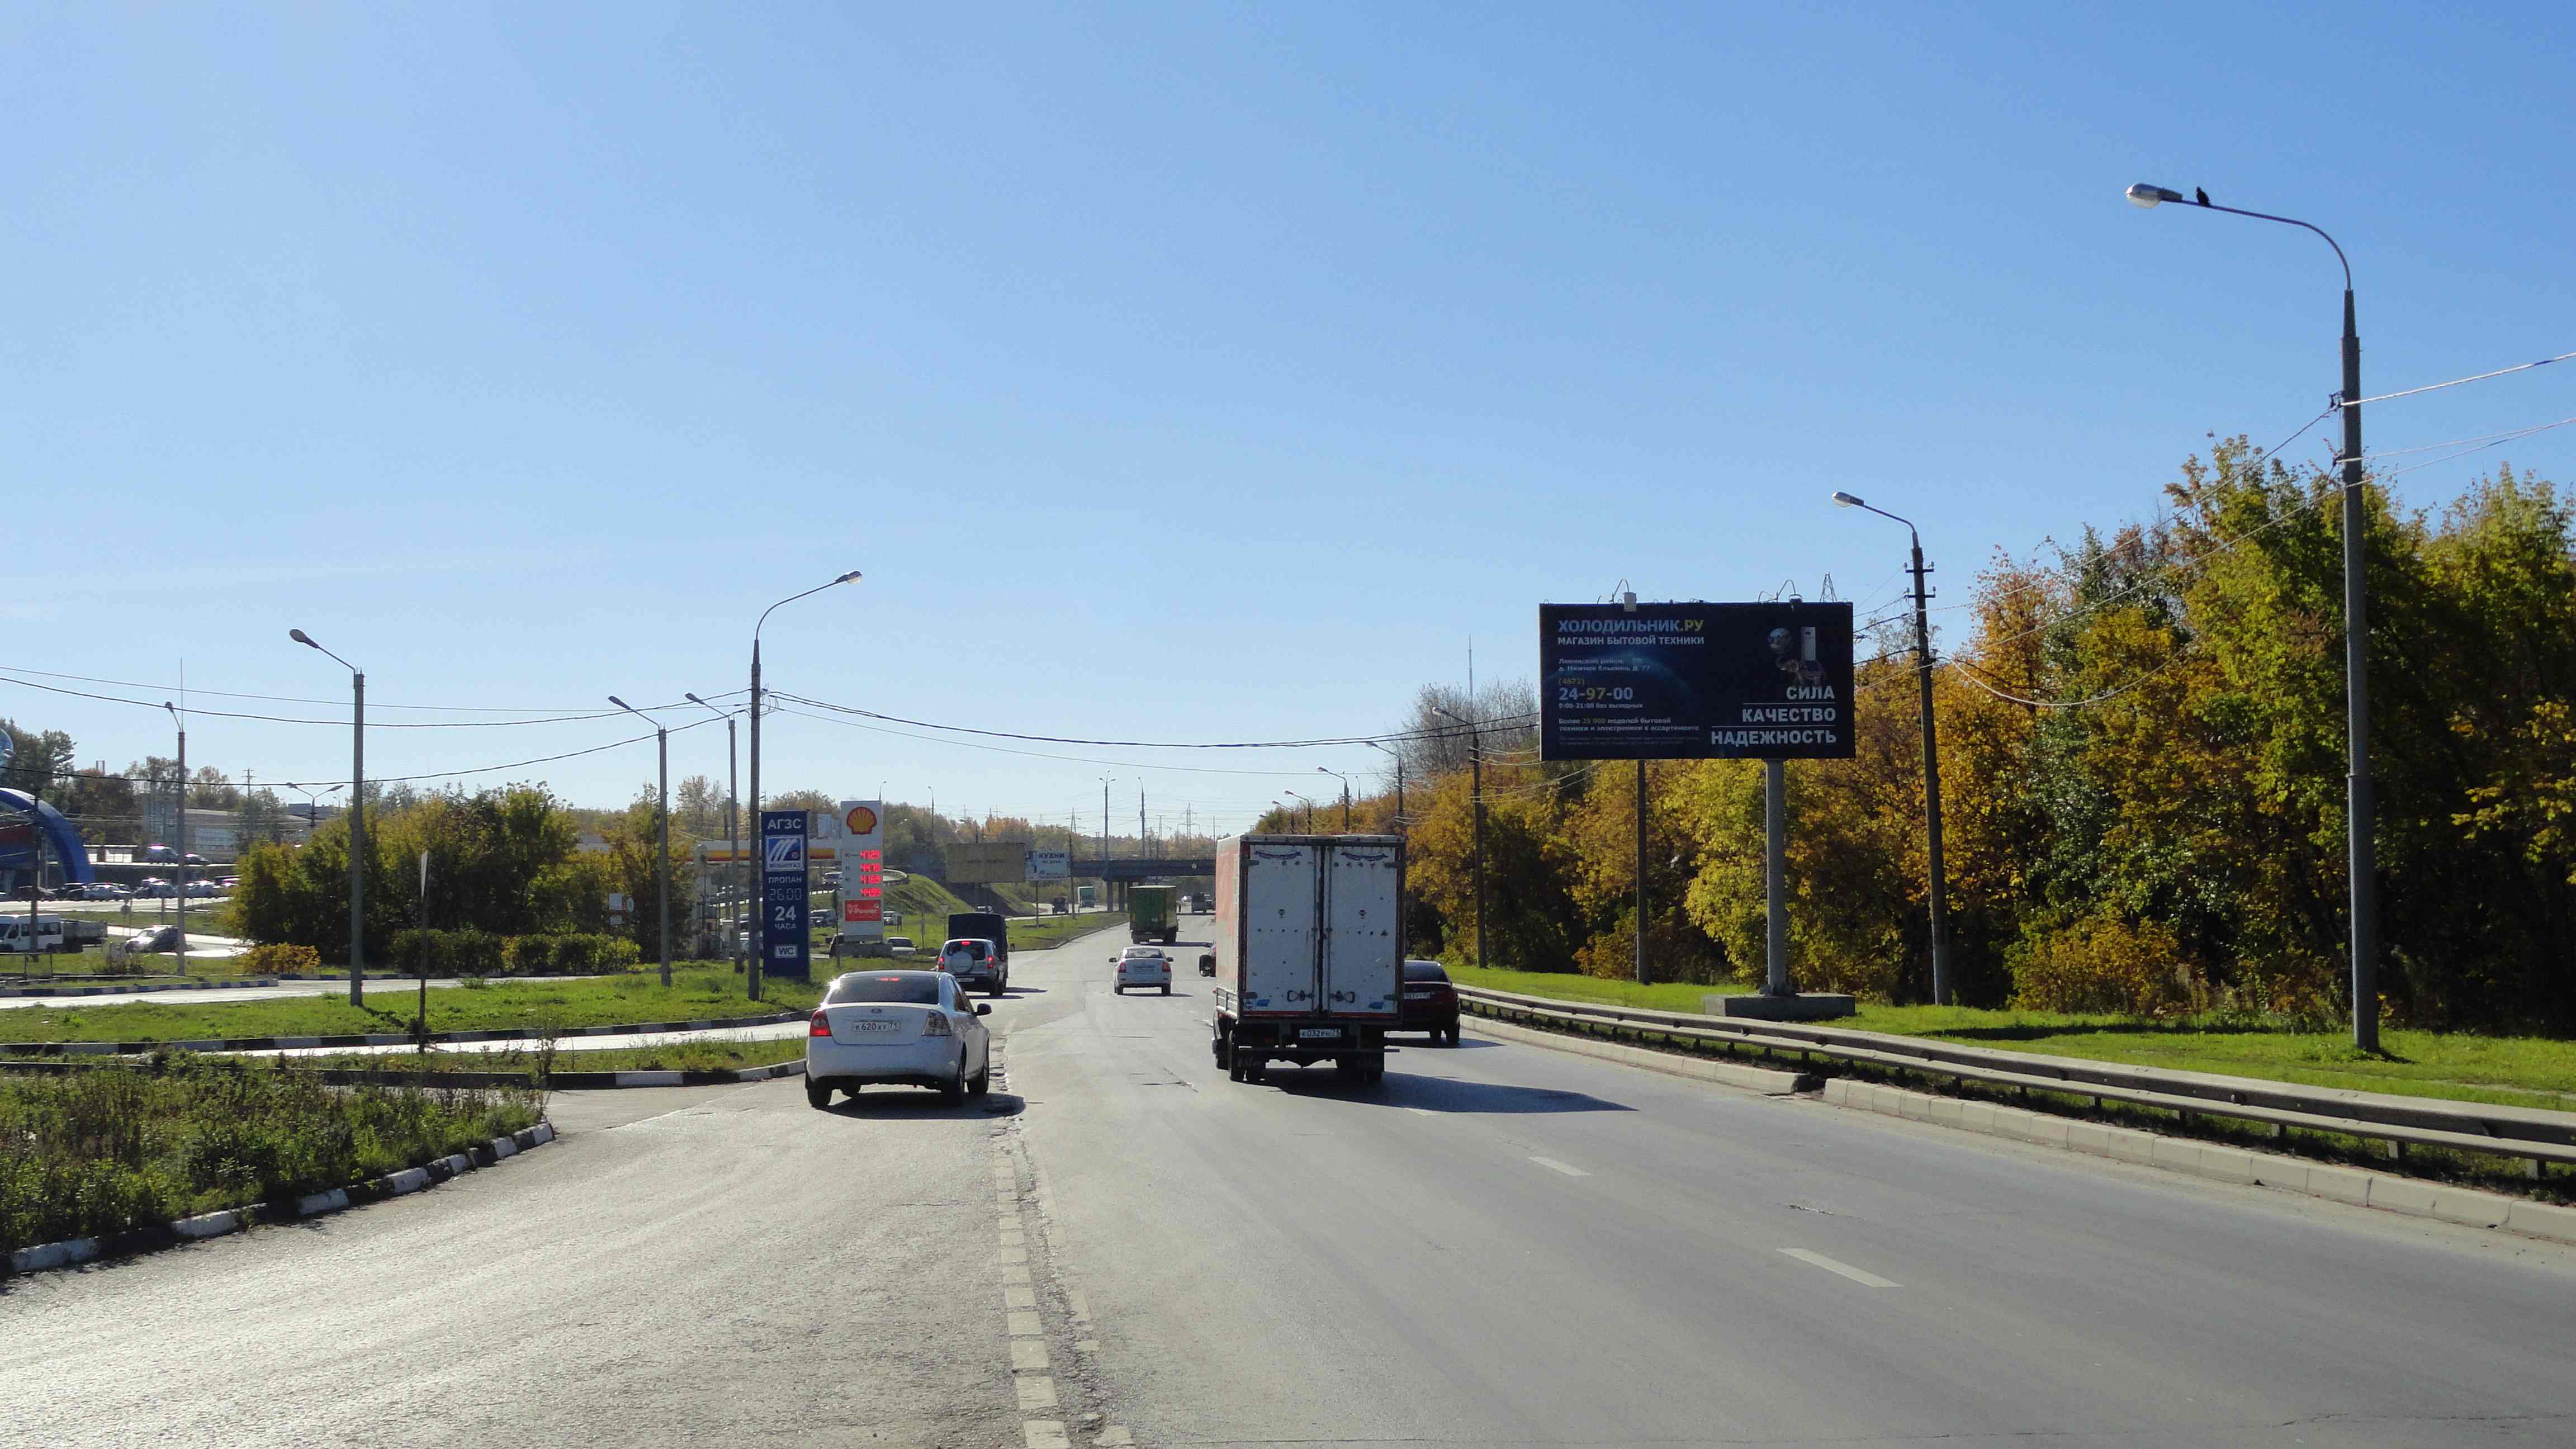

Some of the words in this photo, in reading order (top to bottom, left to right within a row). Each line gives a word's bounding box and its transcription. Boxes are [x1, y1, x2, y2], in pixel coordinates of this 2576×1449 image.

[1558, 619, 1704, 633] ХОЛОДИЛЬНИК.РУ
[1607, 635, 1656, 645] БЫТОВОЙ
[1559, 687, 1633, 700] 24-97-00
[1786, 685, 1835, 699] СИЛА
[1742, 708, 1836, 722] КАЧЕСТВО
[1711, 730, 1836, 747] НАДЕЖНОСТЬ
[768, 818, 801, 829] АГЗС
[775, 905, 797, 921] 24
